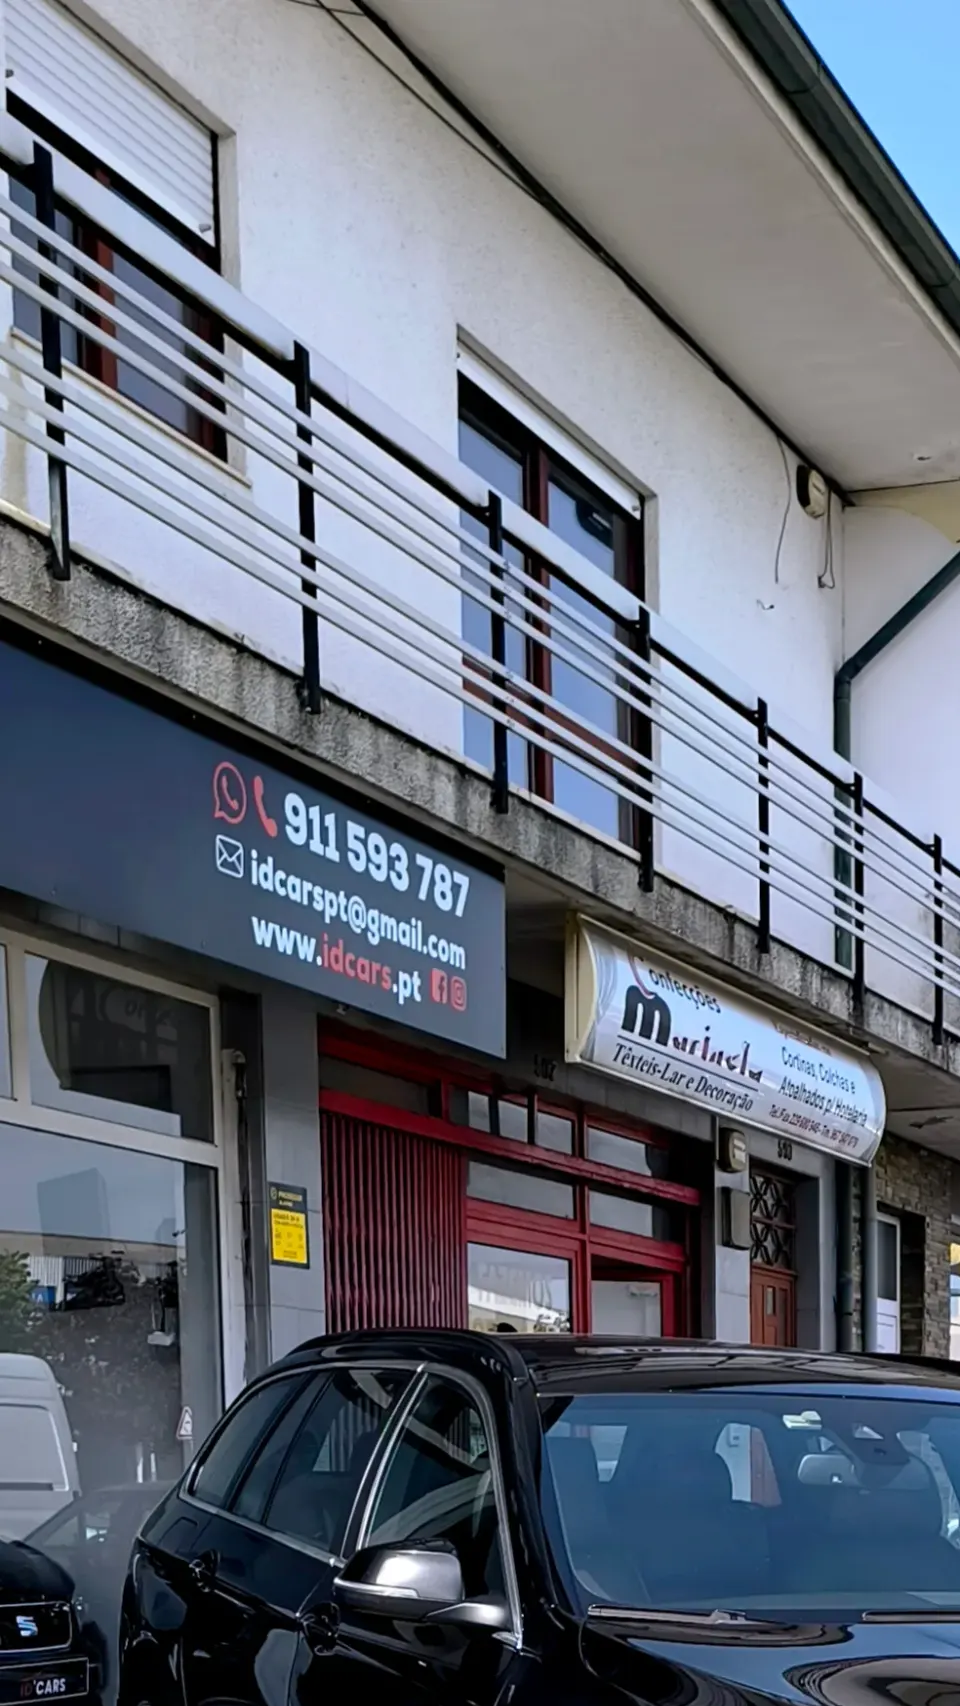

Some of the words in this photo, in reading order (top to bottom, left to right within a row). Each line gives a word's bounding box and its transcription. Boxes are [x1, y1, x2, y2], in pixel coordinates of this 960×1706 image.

[284, 792, 340, 863] 911
[347, 820, 410, 892] 593
[415, 853, 470, 918] 787
[251, 848, 467, 970] idcarspt@gmail.com
[251, 916, 422, 1004] www.idcars.pt
[612, 1042, 686, 1089] Têxteis-Lar
[685, 1074, 694, 1089] e
[694, 1075, 754, 1111] Decoração
[781, 1046, 818, 1080] Cortinas,
